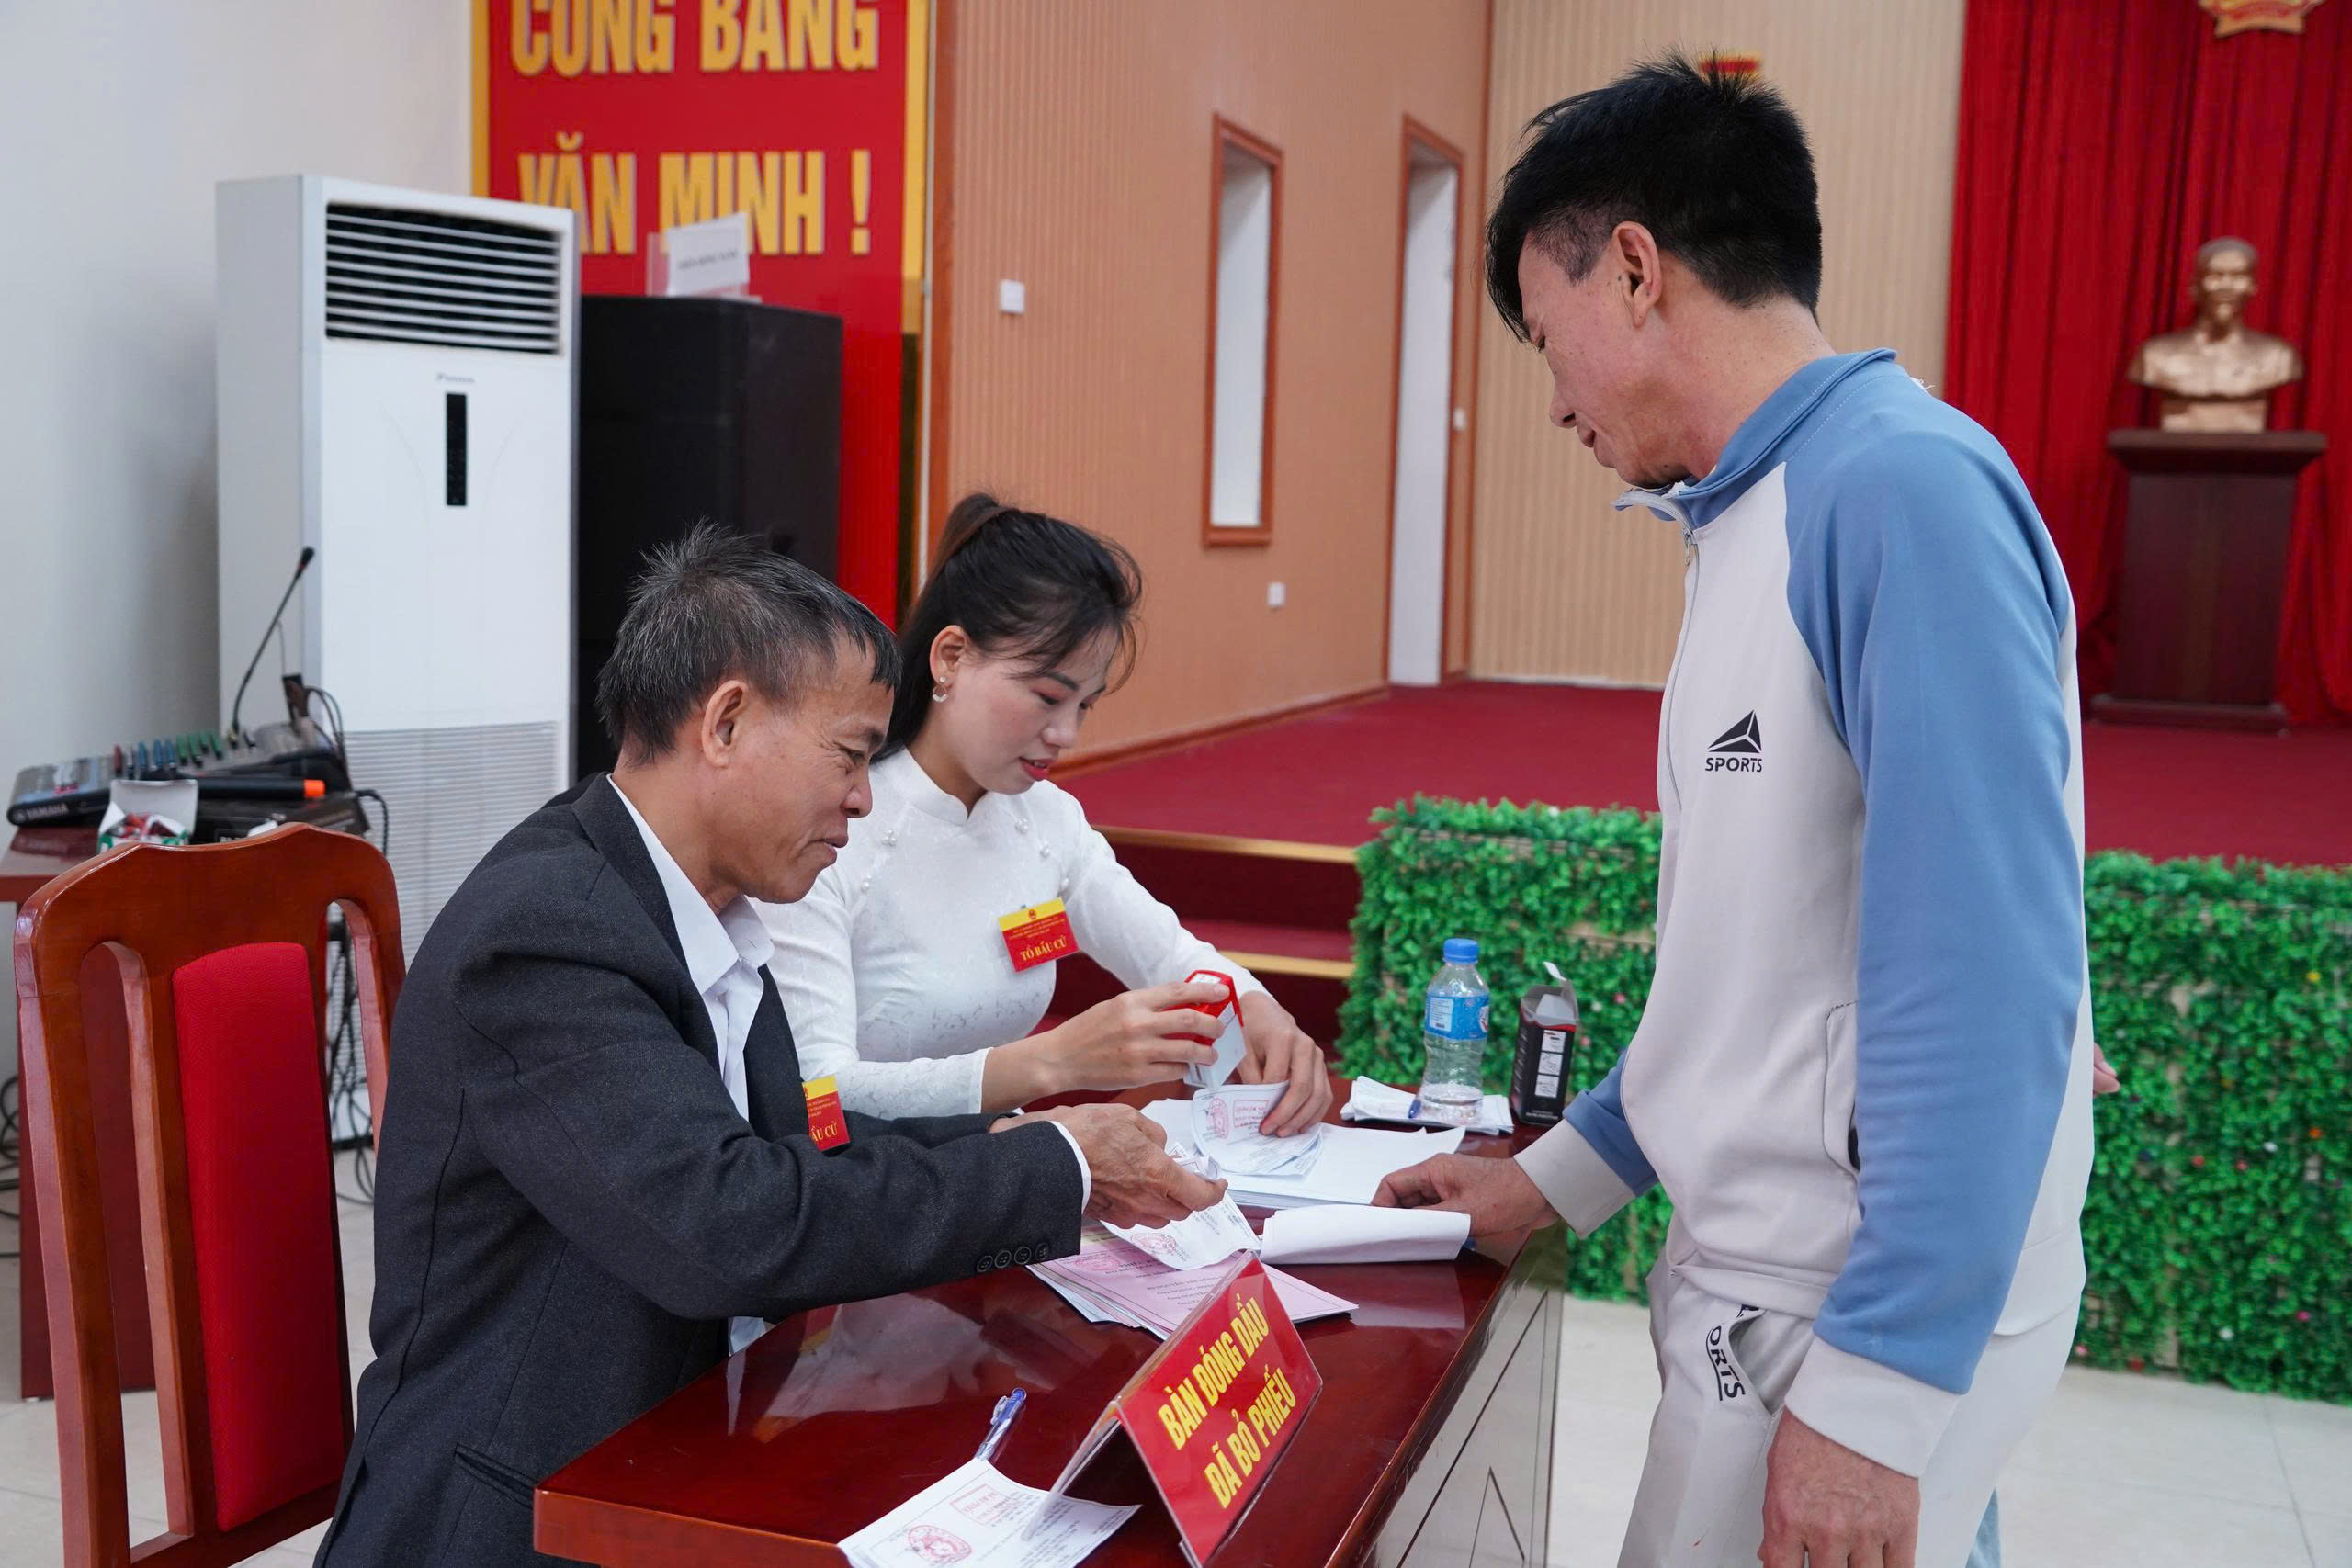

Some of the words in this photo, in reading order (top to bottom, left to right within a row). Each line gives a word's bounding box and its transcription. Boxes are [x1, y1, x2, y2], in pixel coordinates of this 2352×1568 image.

[658, 150, 825, 254] MINH
[1704, 757, 1763, 773] SPORTS
[1158, 1378, 1208, 1450] BÀN
[1192, 1331, 1246, 1407] ĐÓNG
[1230, 1293, 1270, 1359] DẤU
[1204, 1441, 1243, 1509] ĐÃ
[1227, 1408, 1261, 1477] BỎ
[1247, 1364, 1296, 1448] PHIẾU
